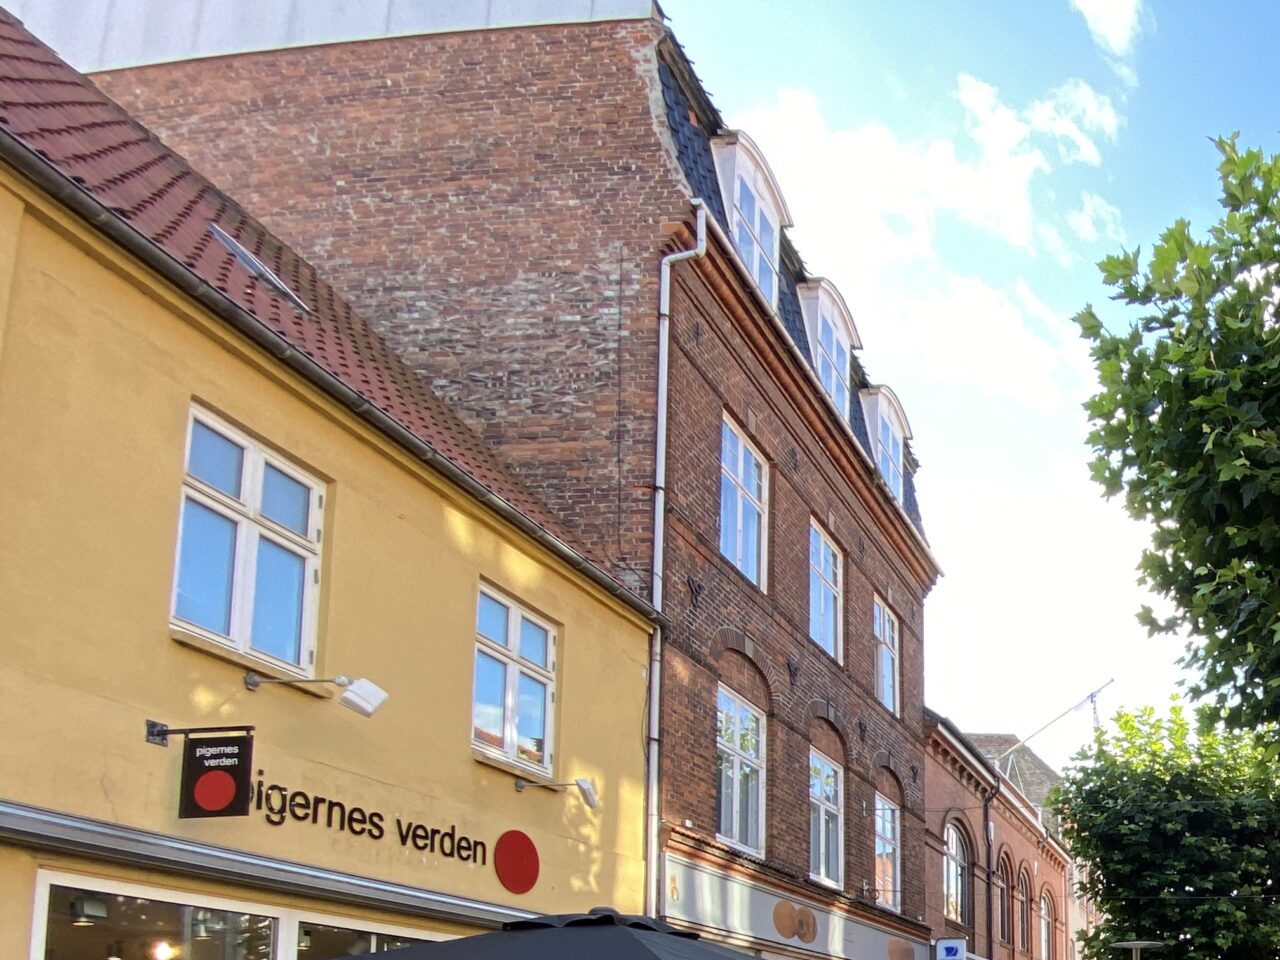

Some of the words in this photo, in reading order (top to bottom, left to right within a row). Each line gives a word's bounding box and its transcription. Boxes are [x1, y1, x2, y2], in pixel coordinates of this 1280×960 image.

[196, 745, 239, 757] pigernes
[204, 757, 238, 766] verden
[249, 769, 384, 840] igernes
[396, 818, 487, 865] verden
